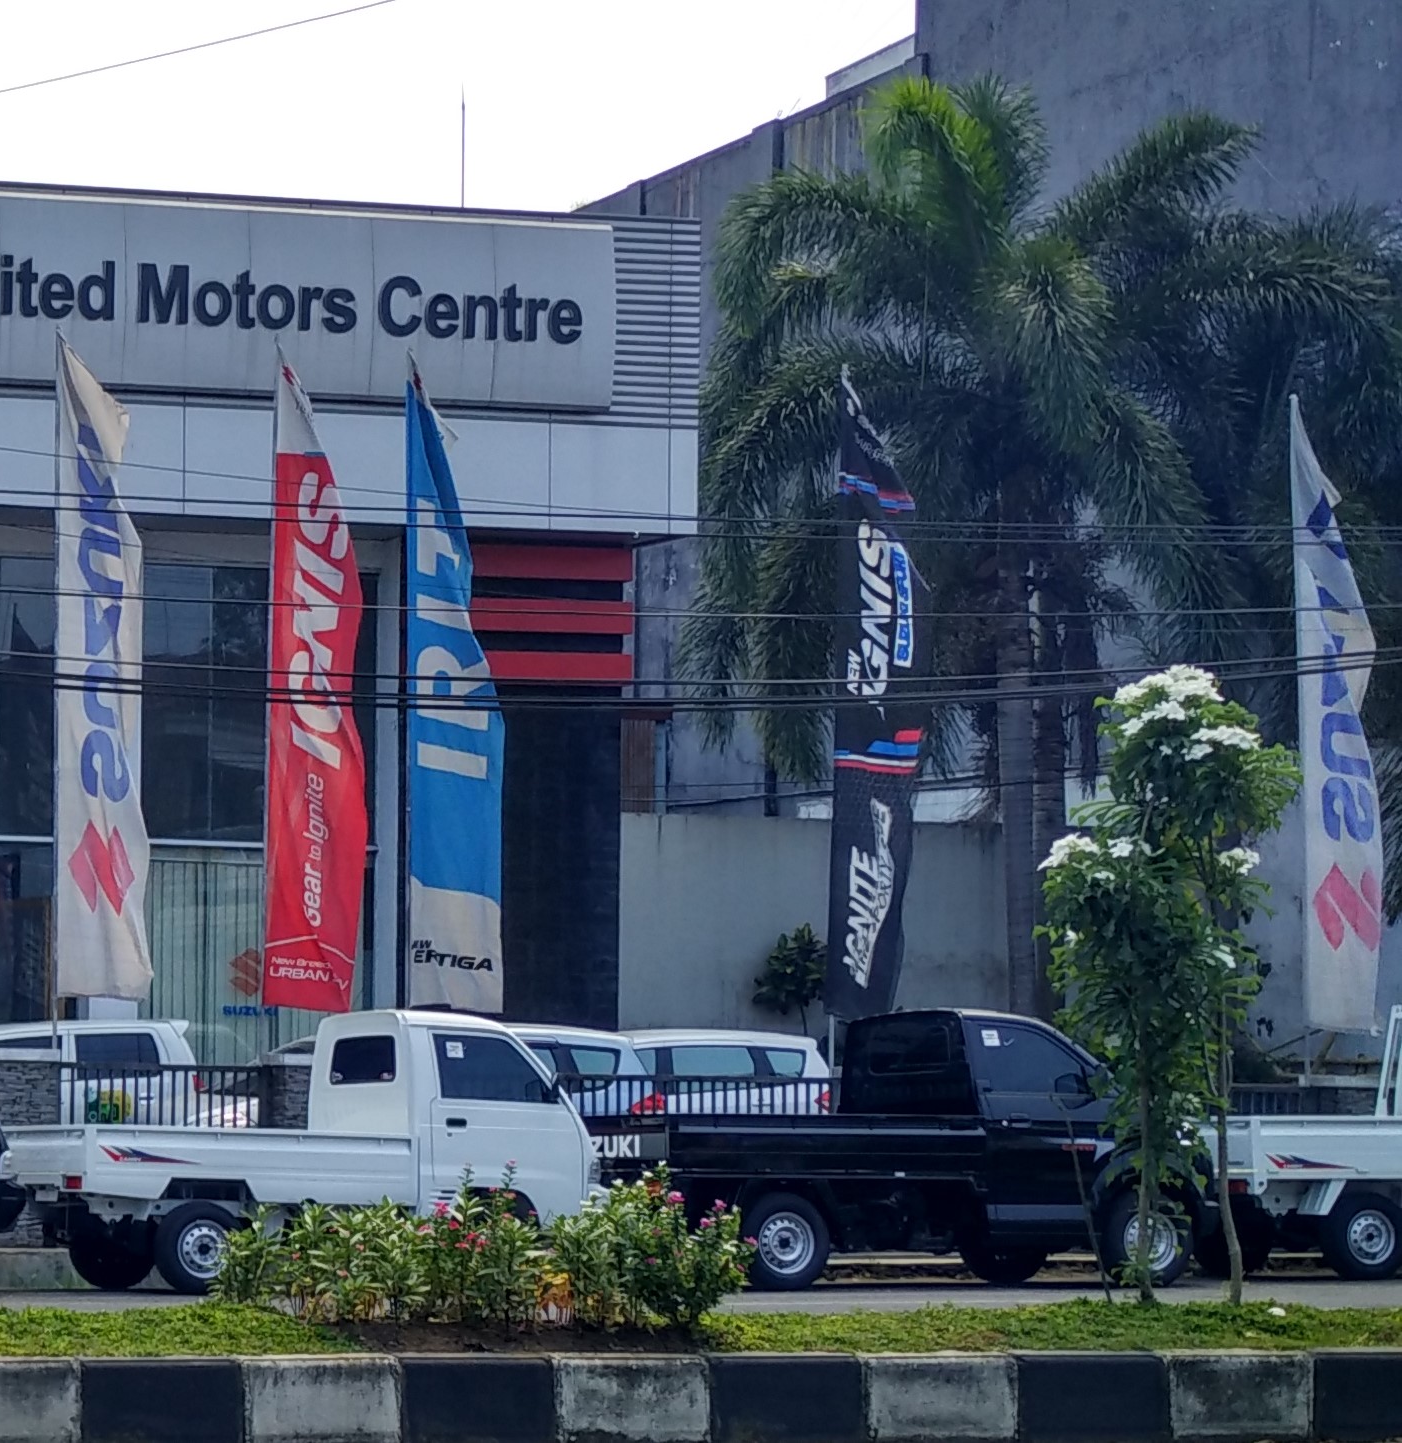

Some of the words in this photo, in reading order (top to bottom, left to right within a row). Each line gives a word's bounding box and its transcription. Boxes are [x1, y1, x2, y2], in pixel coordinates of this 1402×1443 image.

[136, 262, 358, 333] Motors
[378, 275, 584, 344] Centre
[302, 772, 329, 851] Ignite
[307, 844, 322, 862] to
[302, 866, 323, 928] Gear
[271, 955, 295, 966] New
[413, 949, 494, 972] ERTIGA
[269, 966, 331, 982] URBAN
[589, 1133, 641, 1158] ZUKI
